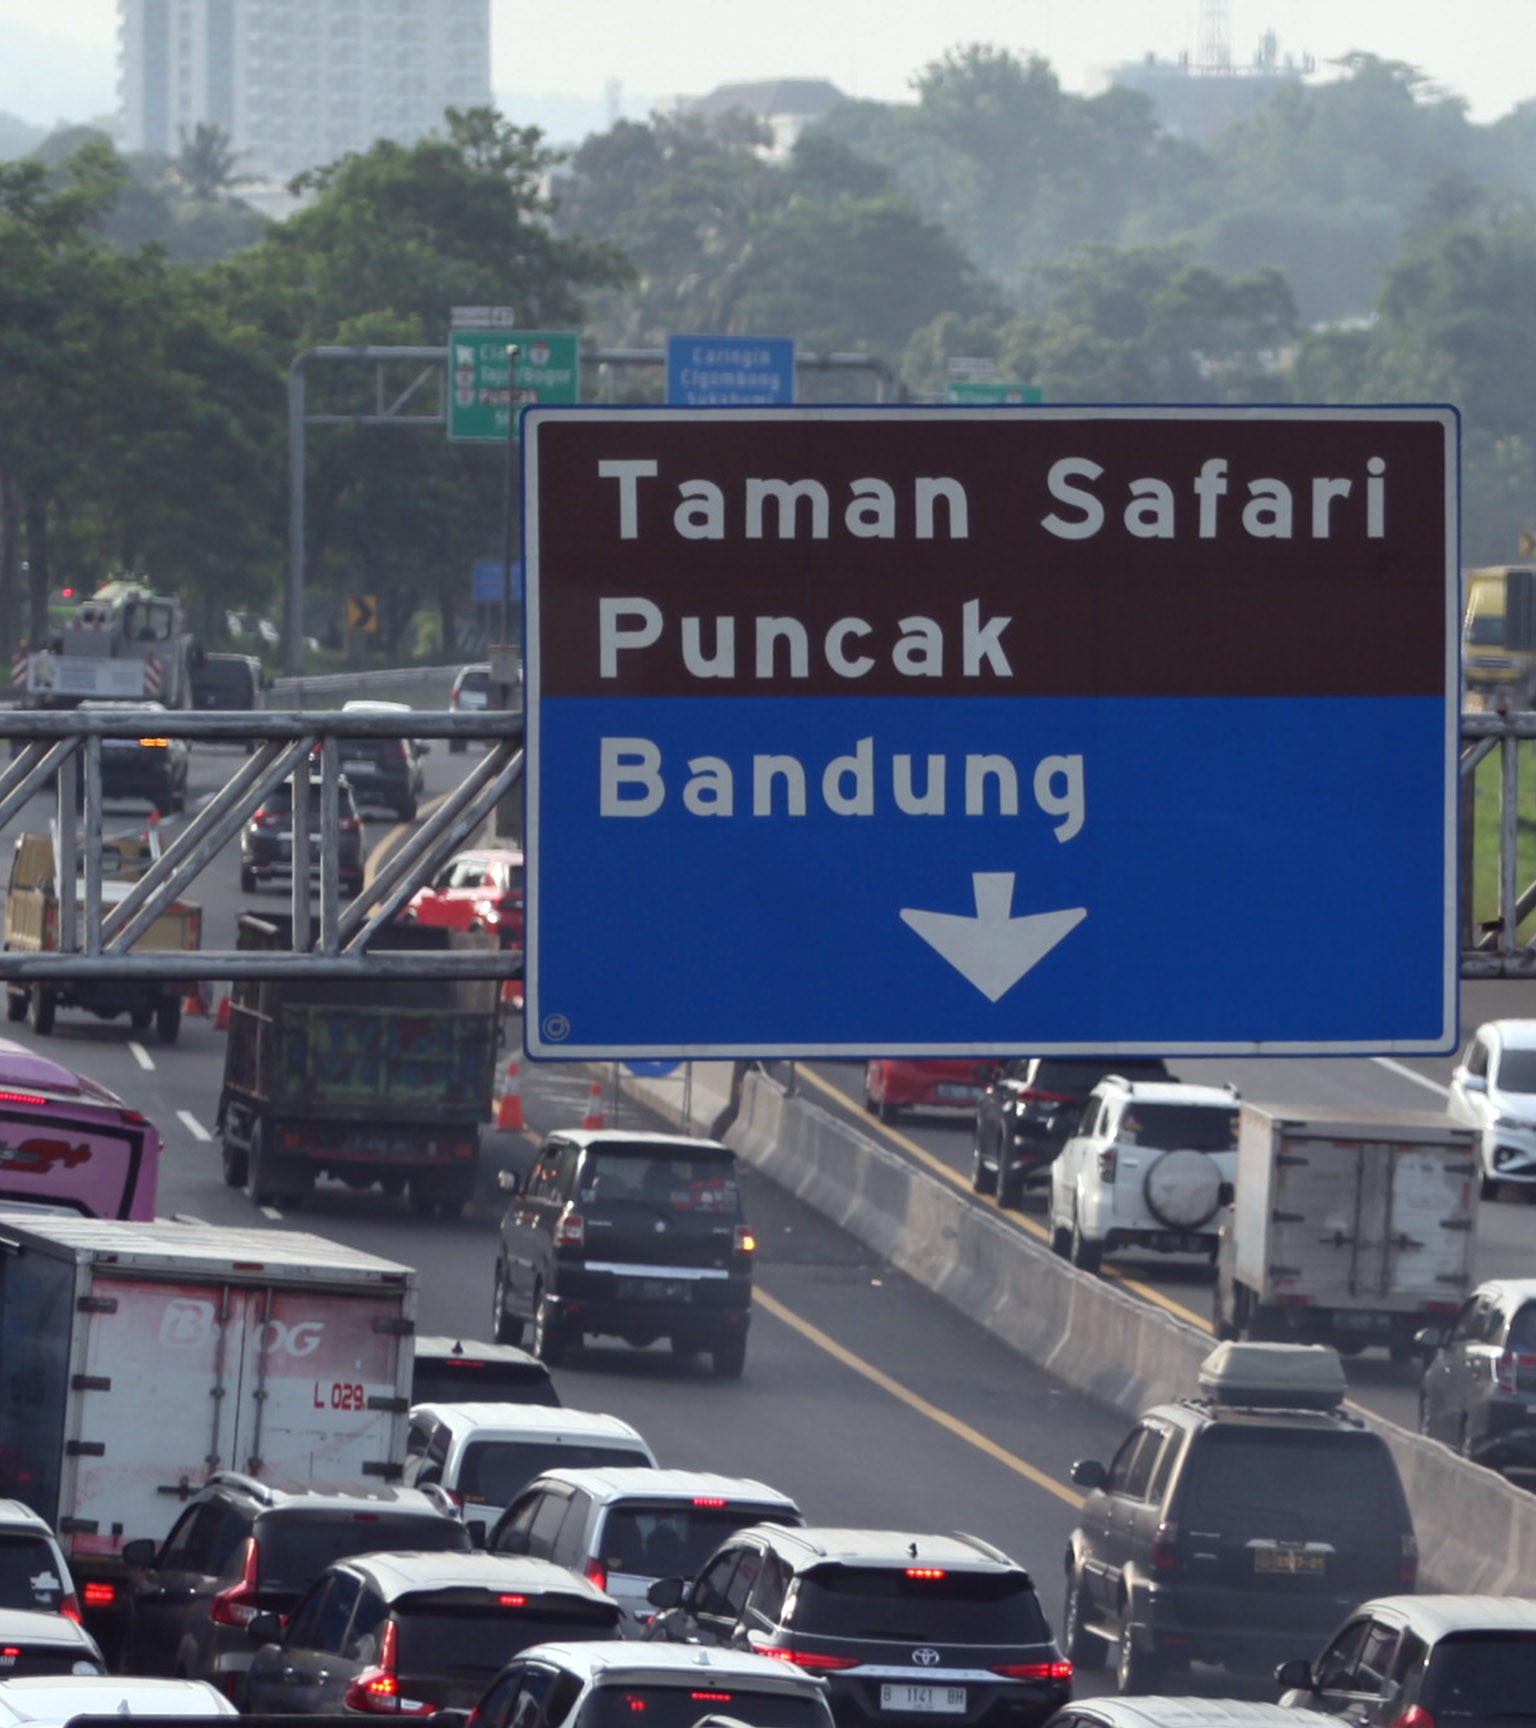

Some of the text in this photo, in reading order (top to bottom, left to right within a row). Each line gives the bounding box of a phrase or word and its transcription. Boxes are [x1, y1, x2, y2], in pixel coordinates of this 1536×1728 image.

[597, 456, 1387, 541] Taman Safari
[598, 597, 1014, 679] Puncak
[599, 736, 1086, 845] Bandung
[313, 1381, 325, 1409] L
